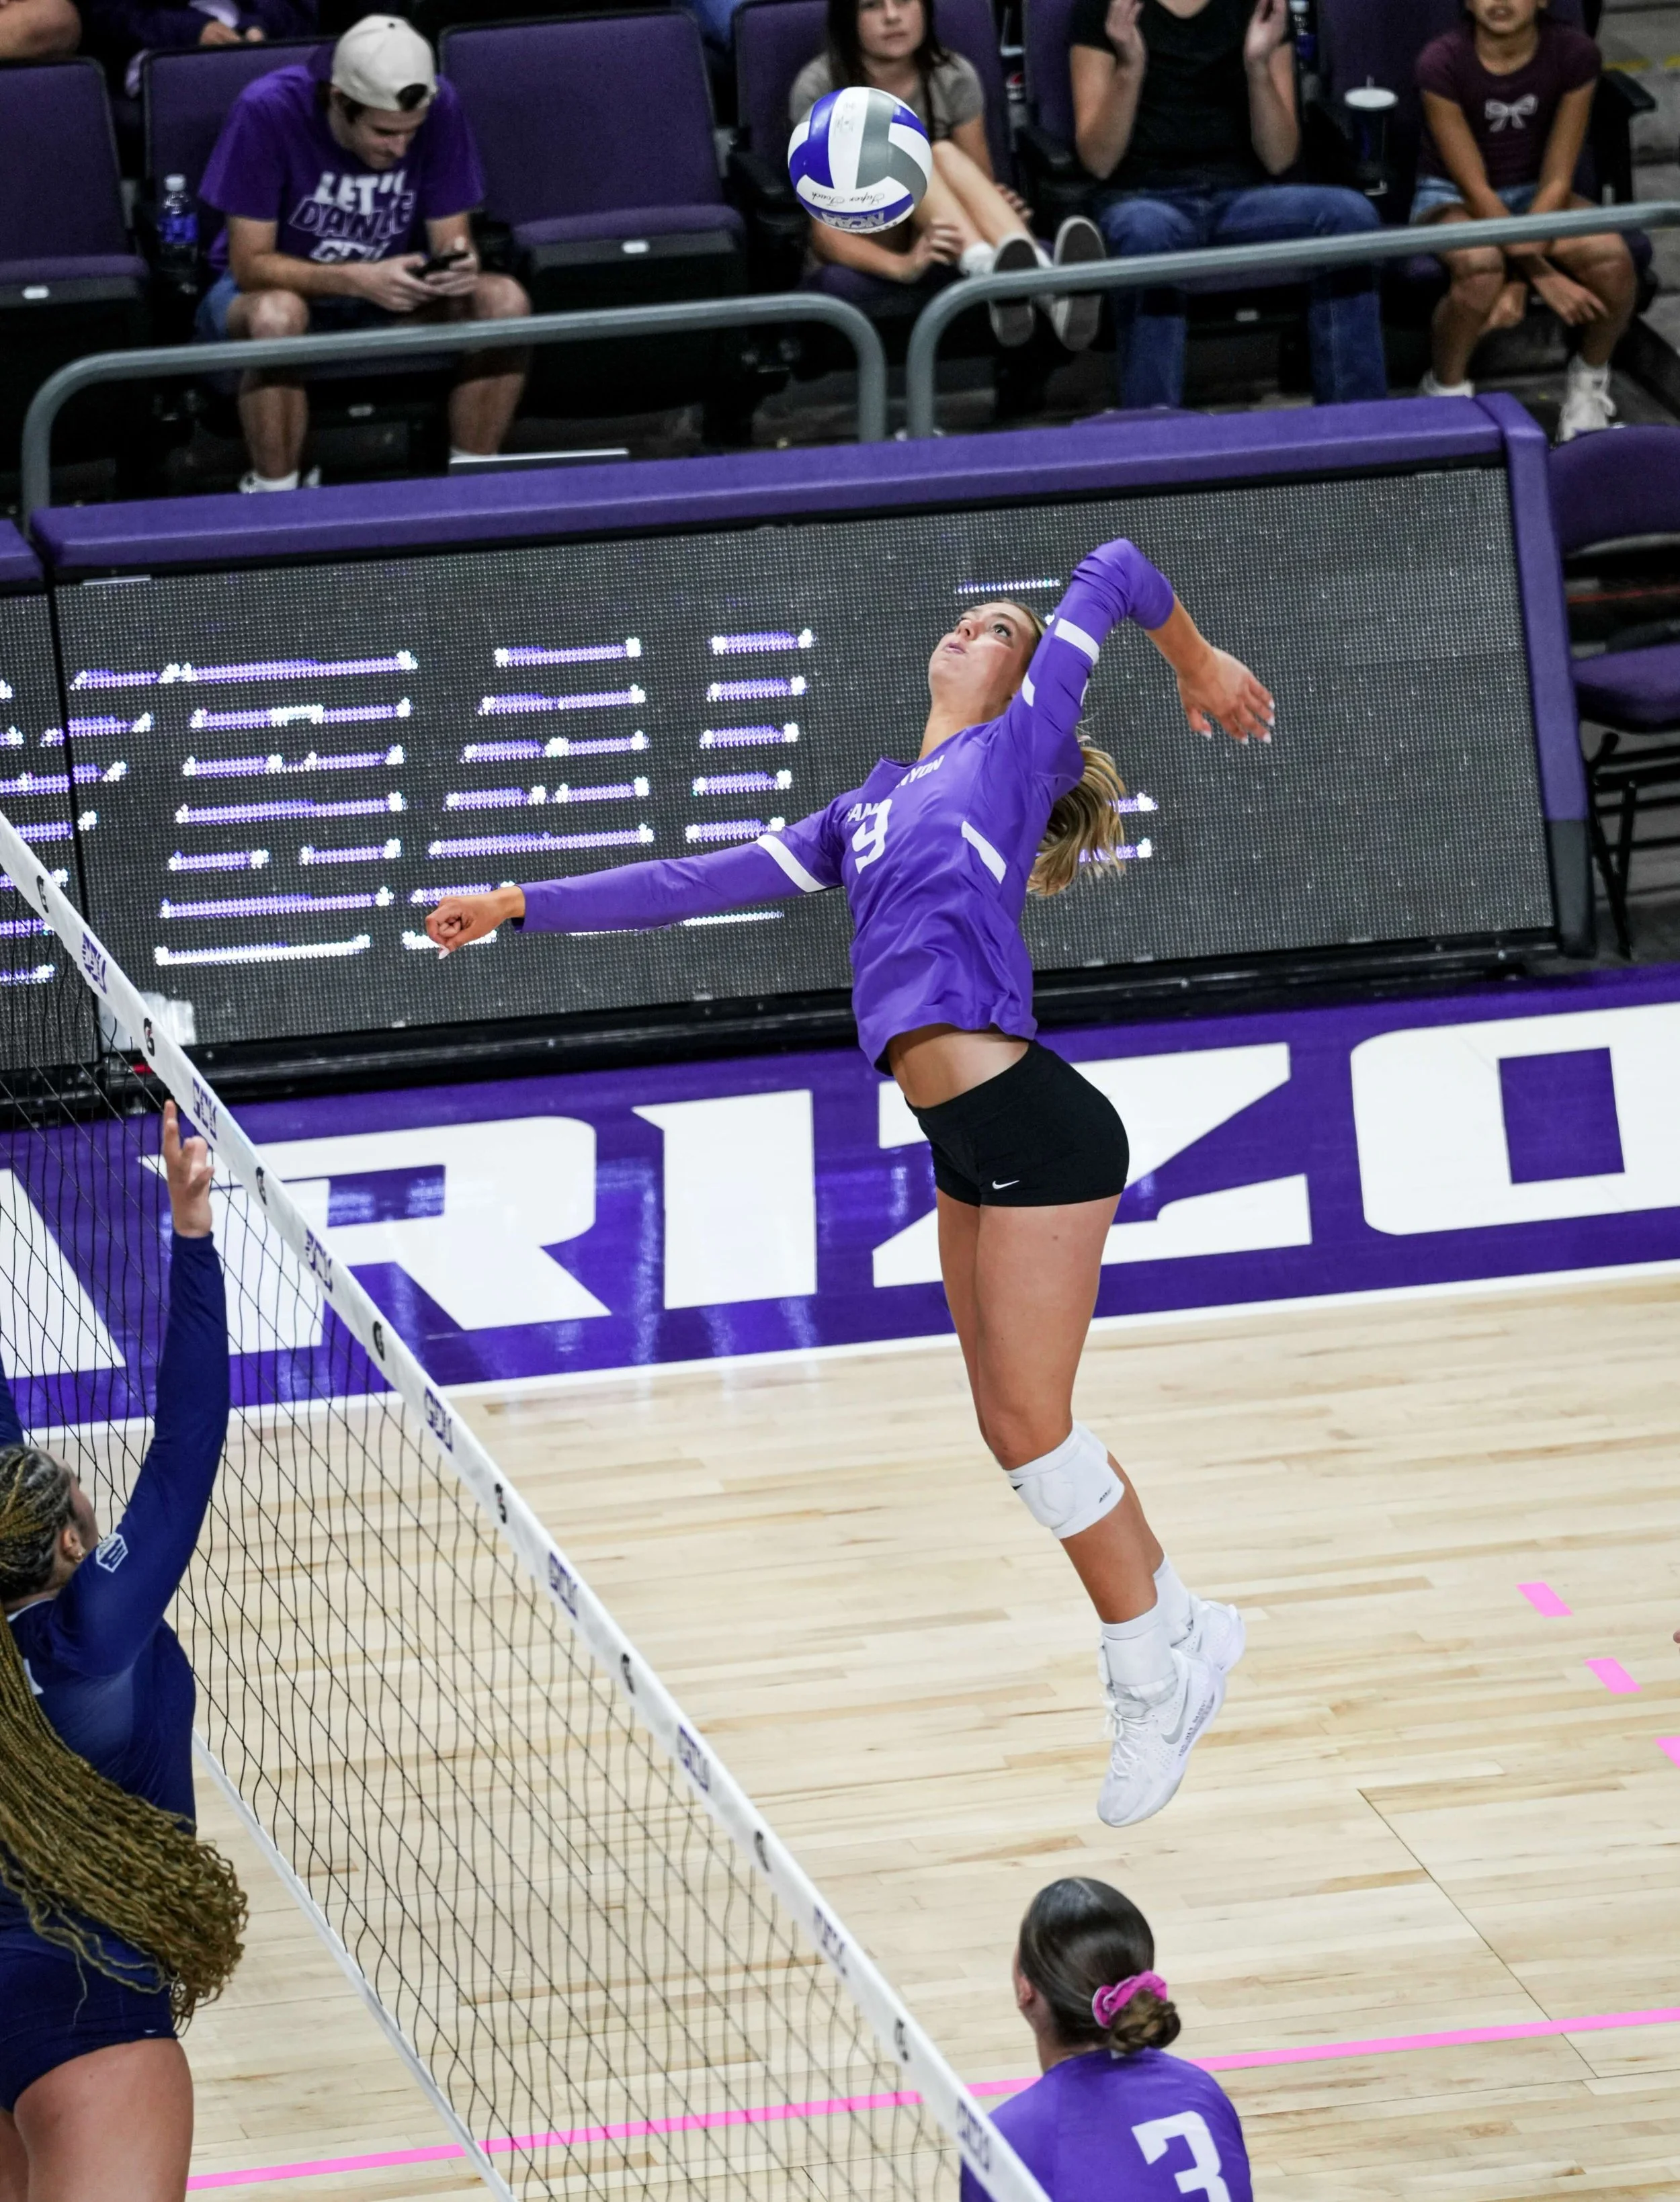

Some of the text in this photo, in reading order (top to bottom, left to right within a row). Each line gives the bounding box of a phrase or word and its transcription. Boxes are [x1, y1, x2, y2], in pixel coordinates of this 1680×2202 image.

[811, 191, 885, 208] Super Touch
[821, 210, 885, 229] NCAA
[851, 798, 893, 875] 9
[1132, 2111, 1236, 2202] 3
